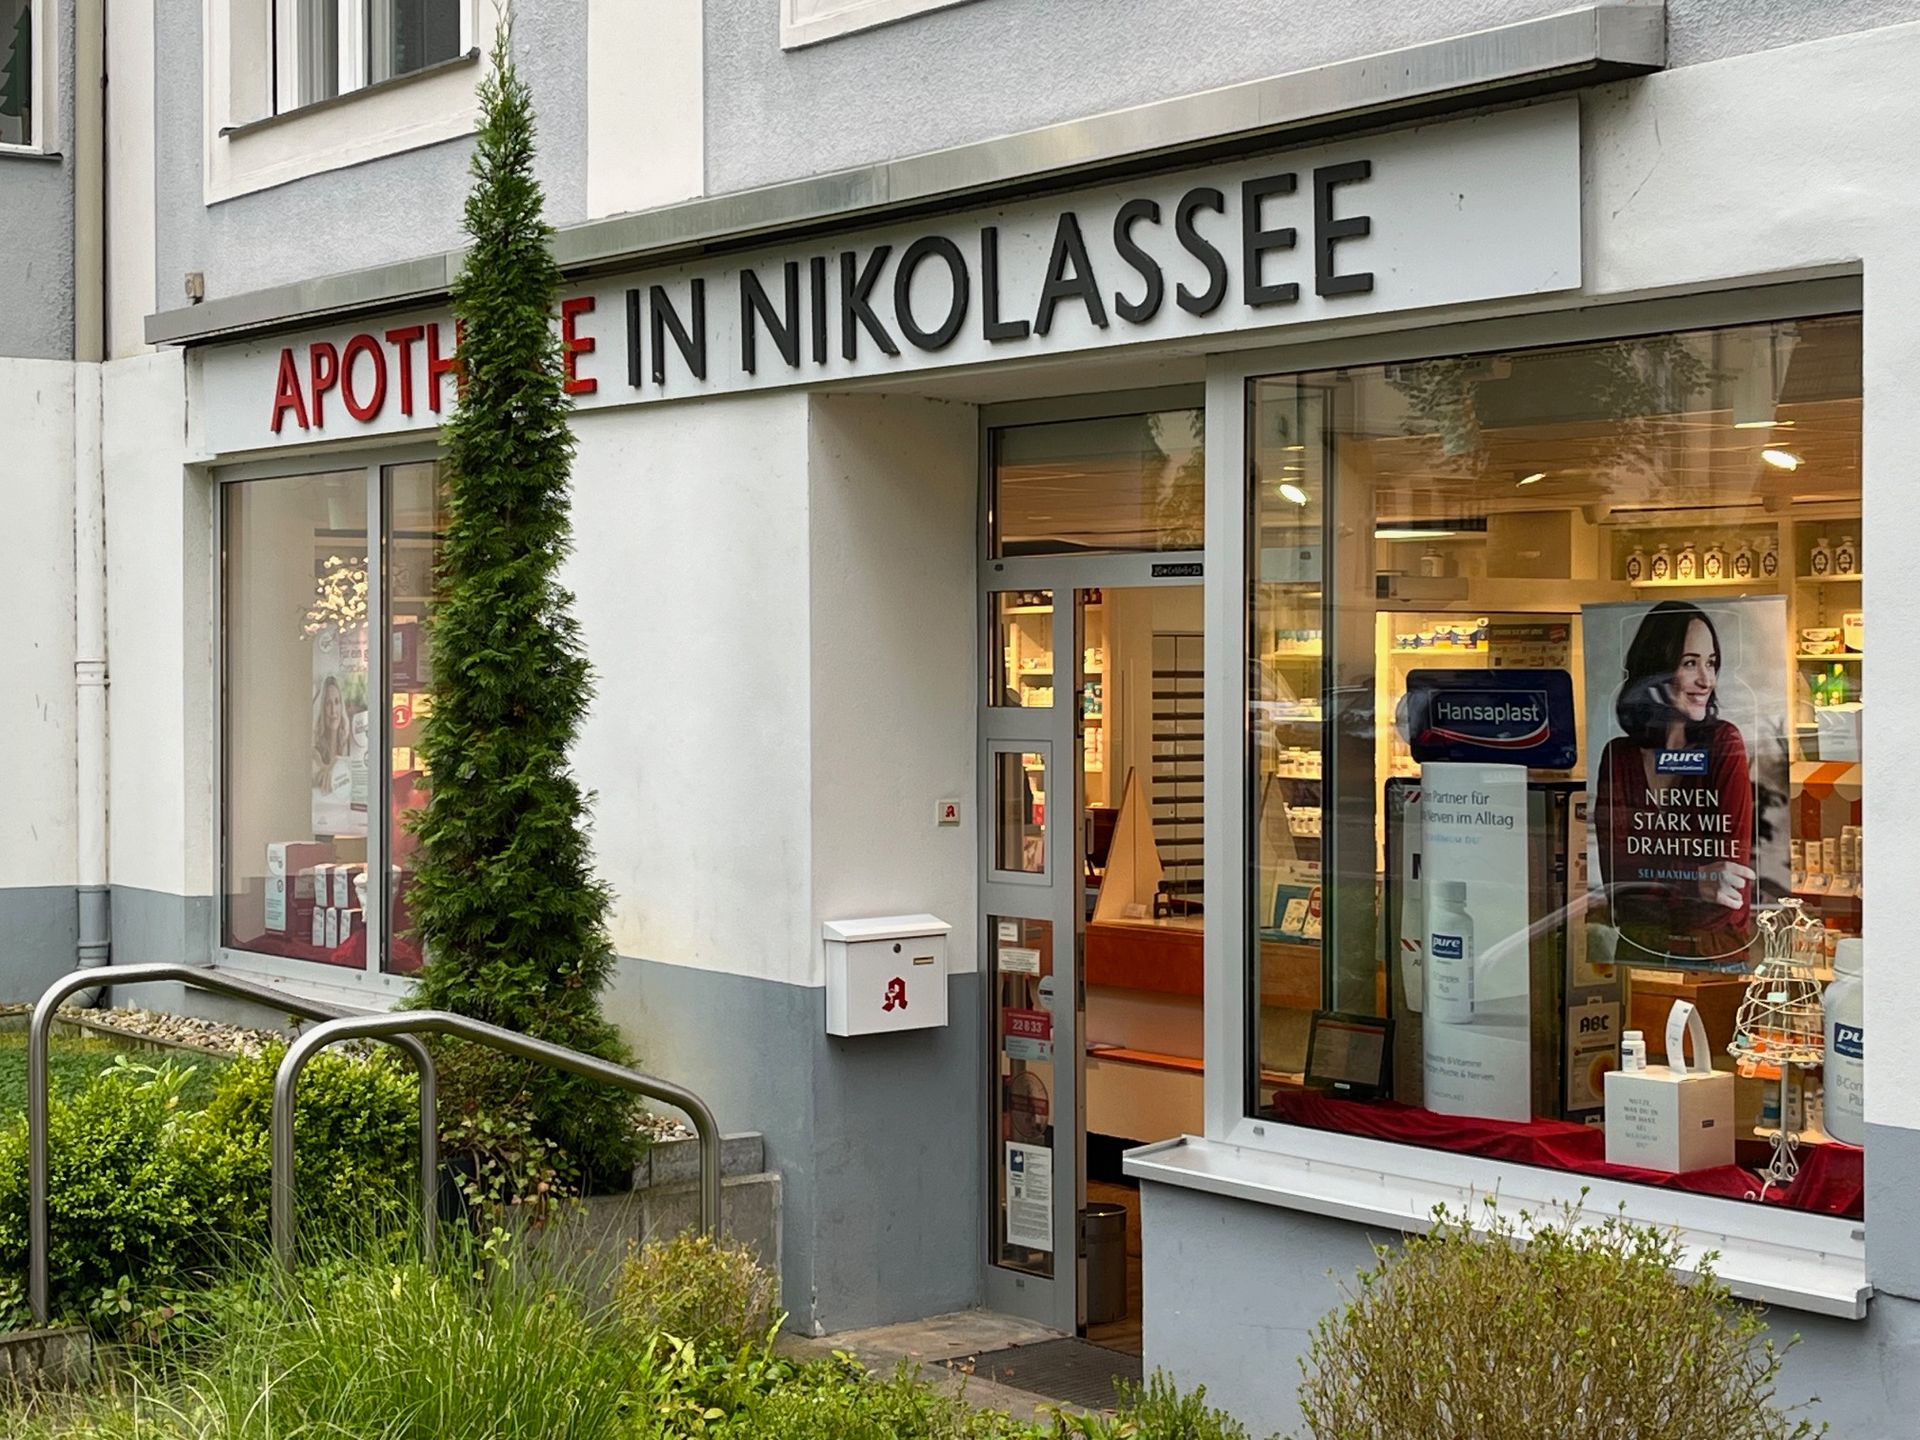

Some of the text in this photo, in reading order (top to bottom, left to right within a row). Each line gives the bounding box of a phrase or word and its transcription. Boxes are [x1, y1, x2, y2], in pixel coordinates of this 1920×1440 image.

[270, 159, 1374, 434] APOTHE IN NIKOLASSEE
[1438, 702, 1540, 724] Hansaplast
[1658, 752, 1705, 765] pure
[1433, 790, 1467, 805] Partner
[1471, 790, 1490, 805] für
[1645, 788, 1719, 808] NERVEN
[1457, 812, 1472, 825] im
[1475, 811, 1514, 830] Alltag
[1634, 812, 1732, 833] STARK WIE
[1627, 837, 1740, 858] DRAHTSEILE
[1638, 868, 1654, 879] SEI
[1657, 869, 1707, 881] MAXIMUM
[1432, 937, 1461, 949] pure
[1580, 1014, 1609, 1033] ABC
[1837, 1028, 1863, 1044] pu
[1836, 1075, 1863, 1092] B-Com
[1848, 1093, 1863, 1106] Plu
